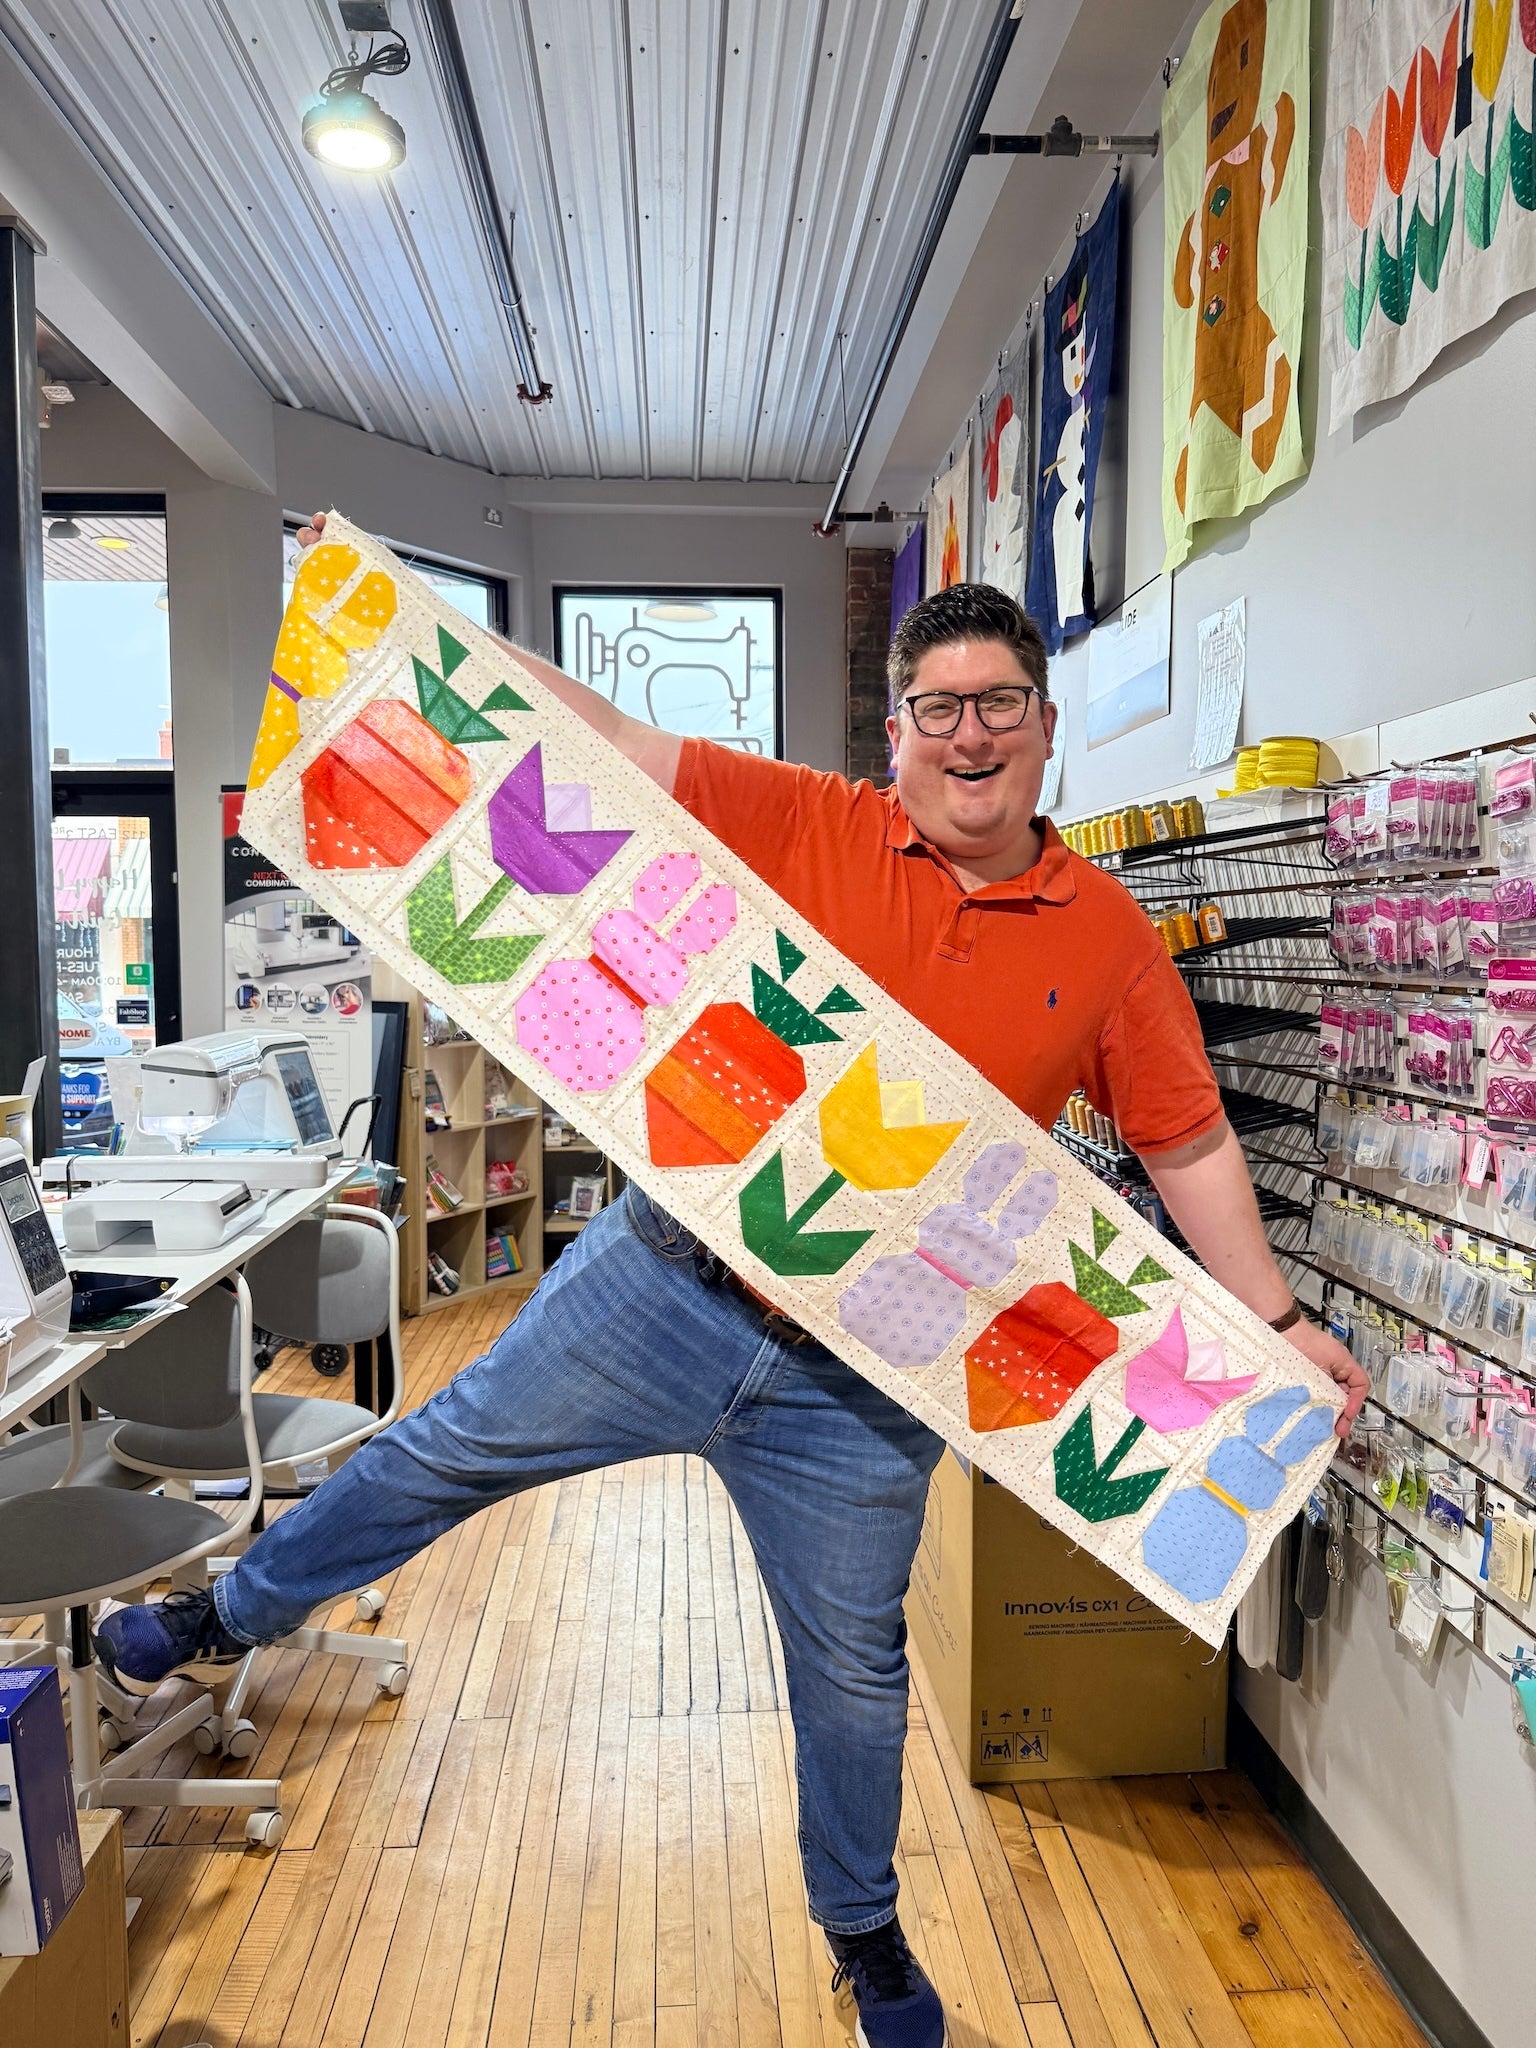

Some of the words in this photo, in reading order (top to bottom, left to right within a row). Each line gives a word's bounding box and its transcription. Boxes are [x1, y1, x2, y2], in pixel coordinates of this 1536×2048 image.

[232, 846, 261, 858] CON
[253, 871, 278, 880] NEXT
[245, 879, 300, 888] COMBINATI
[59, 1029, 92, 1038] NOME
[61, 1083, 79, 1094] ANKS
[66, 1095, 97, 1105] SUPPORT
[1091, 1600, 1119, 1613] CX1
